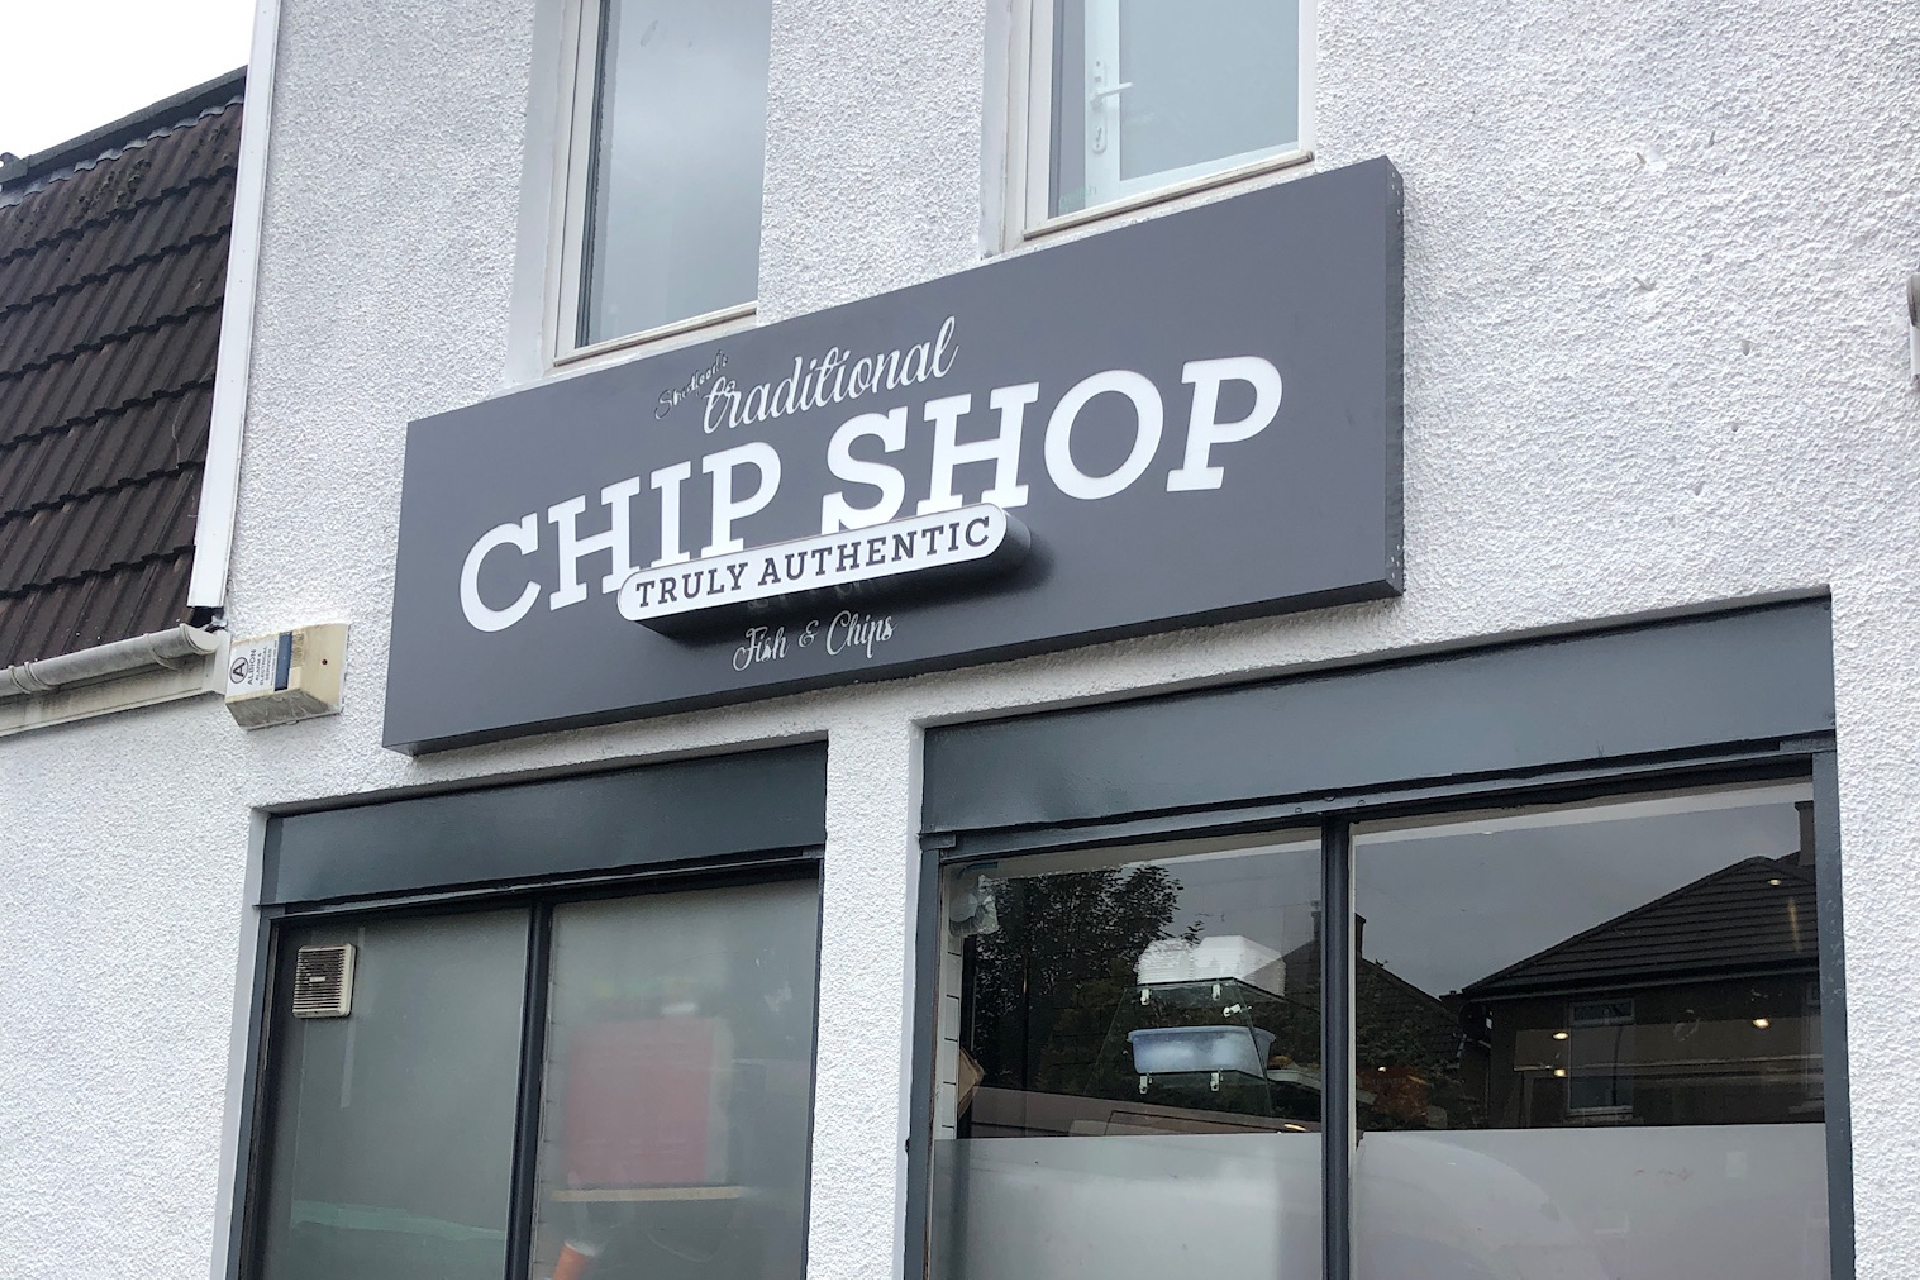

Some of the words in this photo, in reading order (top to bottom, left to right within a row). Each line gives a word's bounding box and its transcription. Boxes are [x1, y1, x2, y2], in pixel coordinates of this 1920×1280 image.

[702, 315, 959, 434] traditional
[459, 442, 782, 633] CHIP
[821, 355, 1283, 534] SHOP
[635, 562, 749, 608] TRULY
[757, 515, 991, 585] AUTHENTIC
[732, 626, 791, 672] Fish
[798, 619, 820, 648] &
[826, 609, 898, 659] Chips
